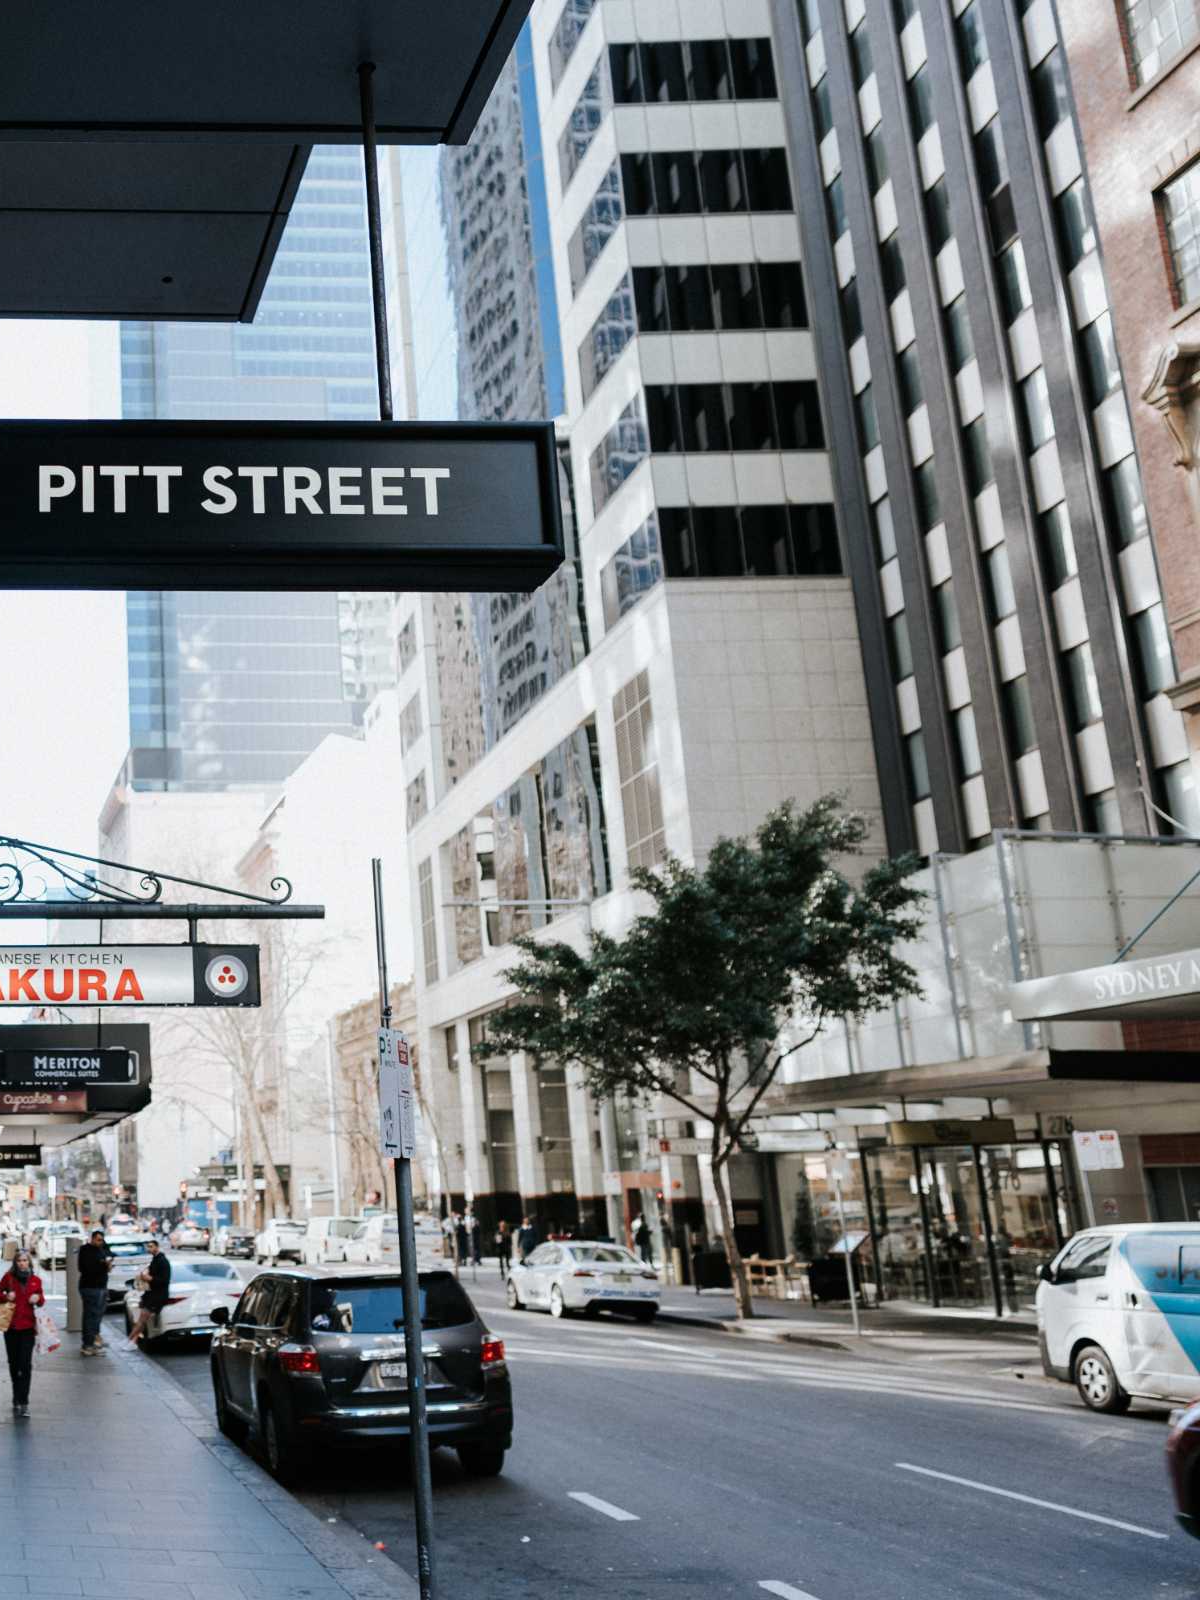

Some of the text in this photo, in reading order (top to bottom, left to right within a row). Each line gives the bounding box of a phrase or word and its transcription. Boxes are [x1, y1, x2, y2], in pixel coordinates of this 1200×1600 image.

[38, 465, 451, 516] PITT STREET
[49, 953, 123, 965] KITCHEN
[1094, 961, 1181, 1001] SYDNEY
[33, 1055, 100, 1070] MERITON
[34, 1070, 76, 1078] COMMERCIAL
